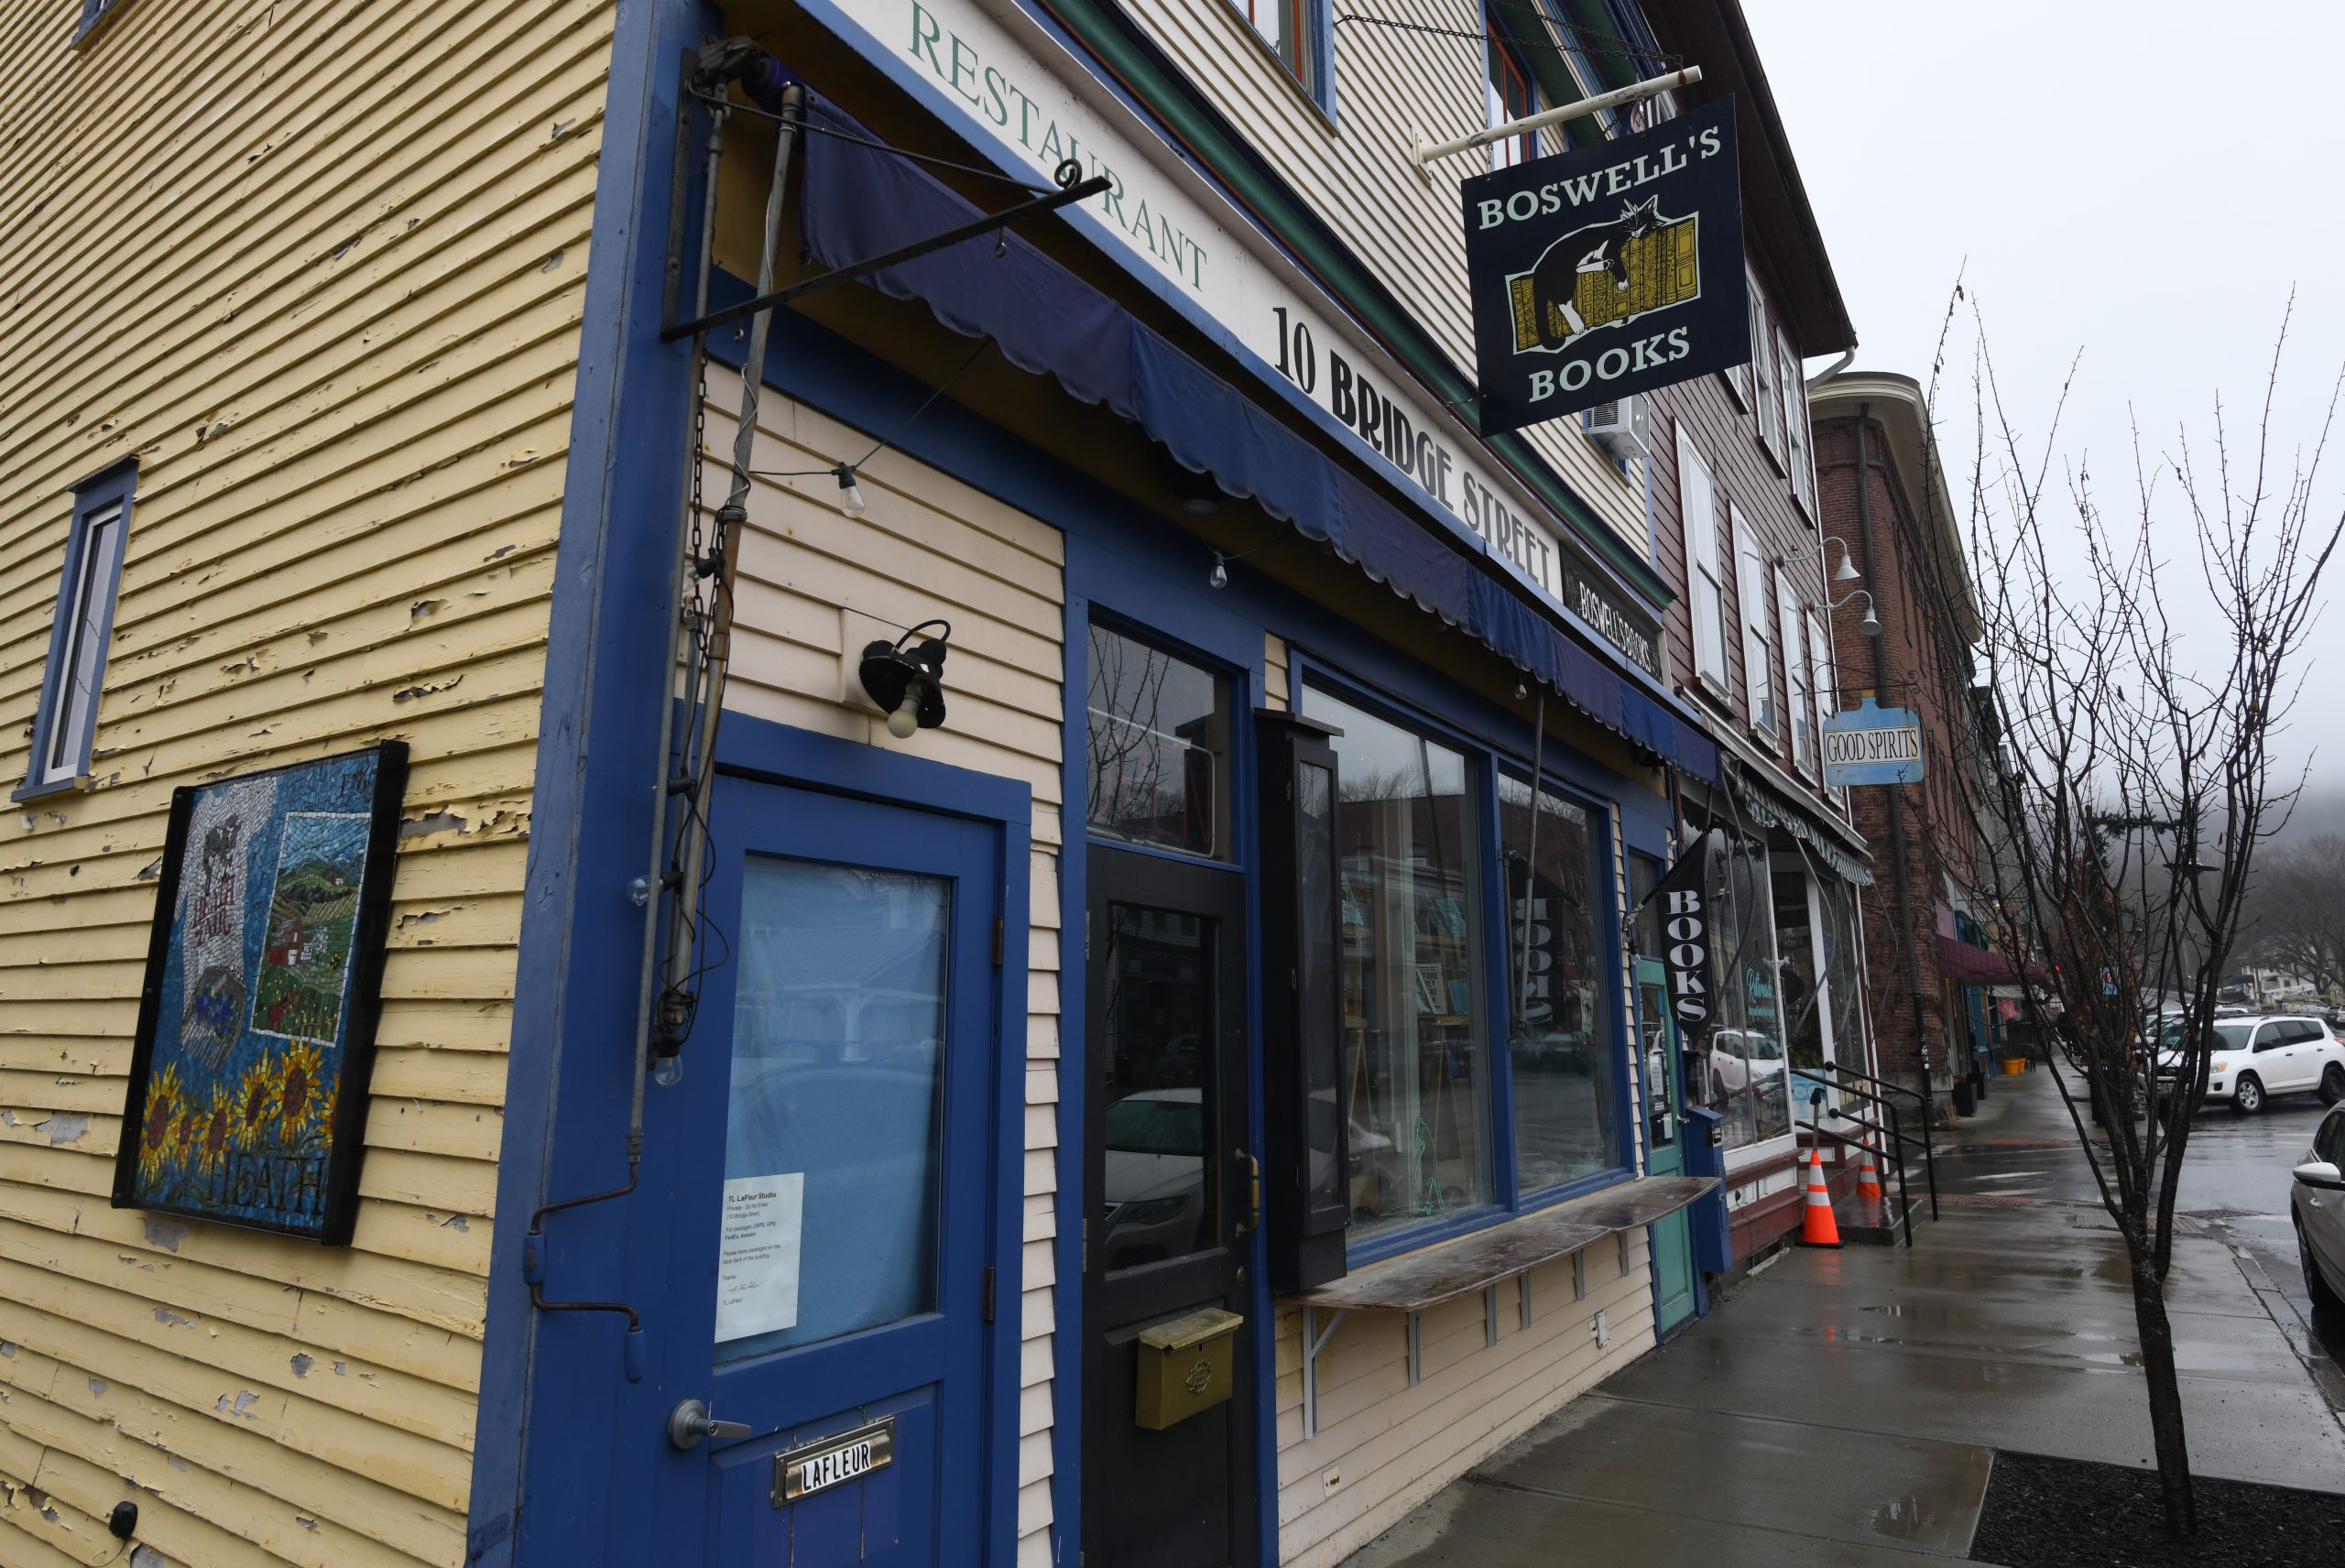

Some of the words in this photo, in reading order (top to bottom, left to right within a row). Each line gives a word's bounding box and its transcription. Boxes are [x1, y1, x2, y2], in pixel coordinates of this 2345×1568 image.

[907, 0, 1207, 292] RESTAURANT
[1477, 125, 1722, 230] BOSWELL'S
[1528, 325, 1691, 404] BOOKS
[1272, 307, 1316, 395] 10
[1329, 348, 1455, 513] BRIDGE
[1462, 472, 1551, 594] STREET
[1579, 580, 1627, 651] BOSWELL'S
[1624, 622, 1652, 672] BOOKS
[1827, 733, 1866, 762] GOOD
[1868, 729, 1918, 759] SPIRITS
[1663, 889, 1707, 1022] BOOKS
[204, 1150, 327, 1215] HEATH
[758, 1192, 777, 1200] Studio
[802, 1443, 870, 1491] LAFLEUR
